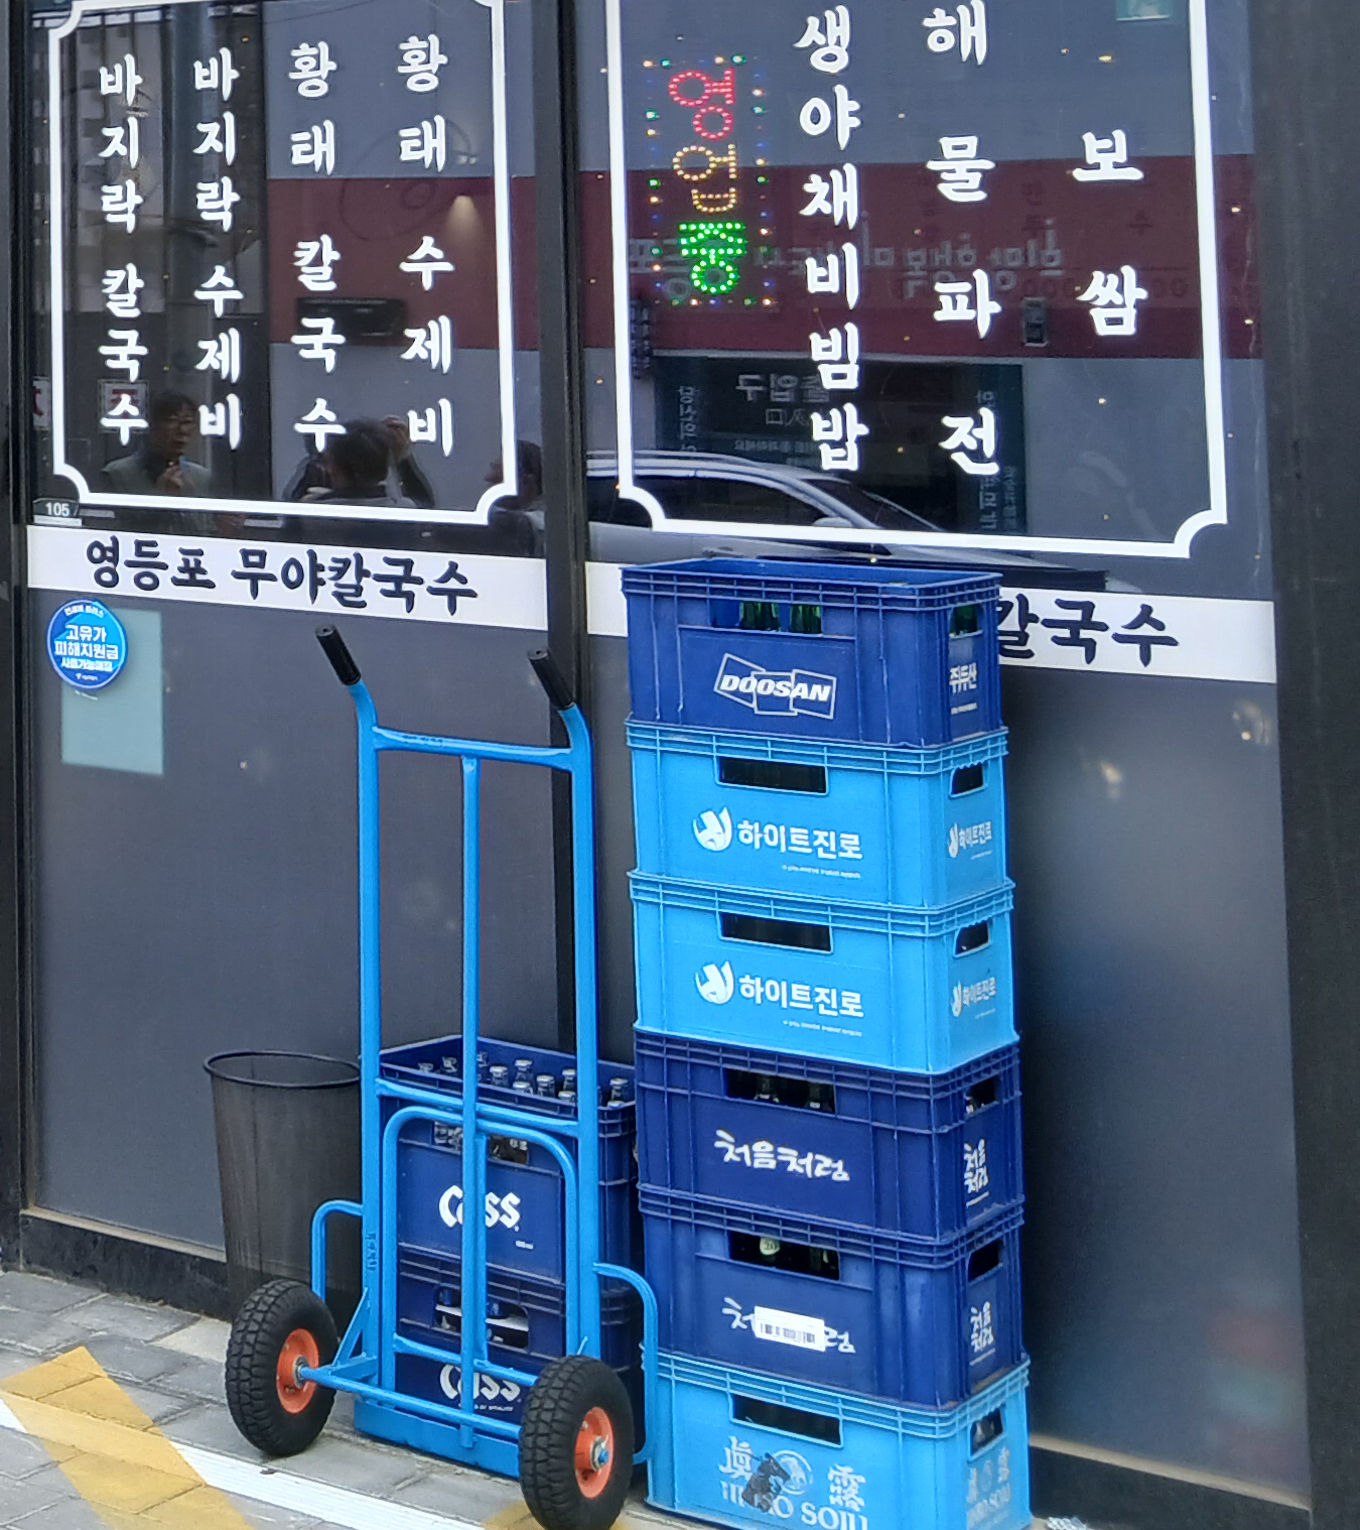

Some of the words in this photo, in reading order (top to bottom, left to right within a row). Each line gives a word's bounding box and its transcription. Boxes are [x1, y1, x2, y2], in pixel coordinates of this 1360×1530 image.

[99, 53, 143, 234] 바지락
[193, 47, 240, 232] 바지락
[289, 40, 338, 175] 황태
[397, 34, 449, 172] 황태
[667, 67, 747, 294] 영업중
[794, 5, 870, 472] 생야채비빔밥
[1072, 129, 1148, 337] 보쌈
[98, 262, 149, 446] 칼국수
[194, 265, 243, 449] 수제비
[291, 234, 347, 453] 칼국수
[399, 235, 455, 457] 수제비
[45, 501, 70, 517] 105
[85, 537, 216, 591] 영등포
[231, 548, 479, 617] 무야칼국수
[53, 640, 119, 660] 피해지원금
[65, 624, 107, 642] 고유가
[719, 673, 832, 703] DOOSAN
[737, 819, 864, 861] 하이트진로
[738, 974, 865, 1018] 하이트진로
[714, 1129, 851, 1182] 처음처럼
